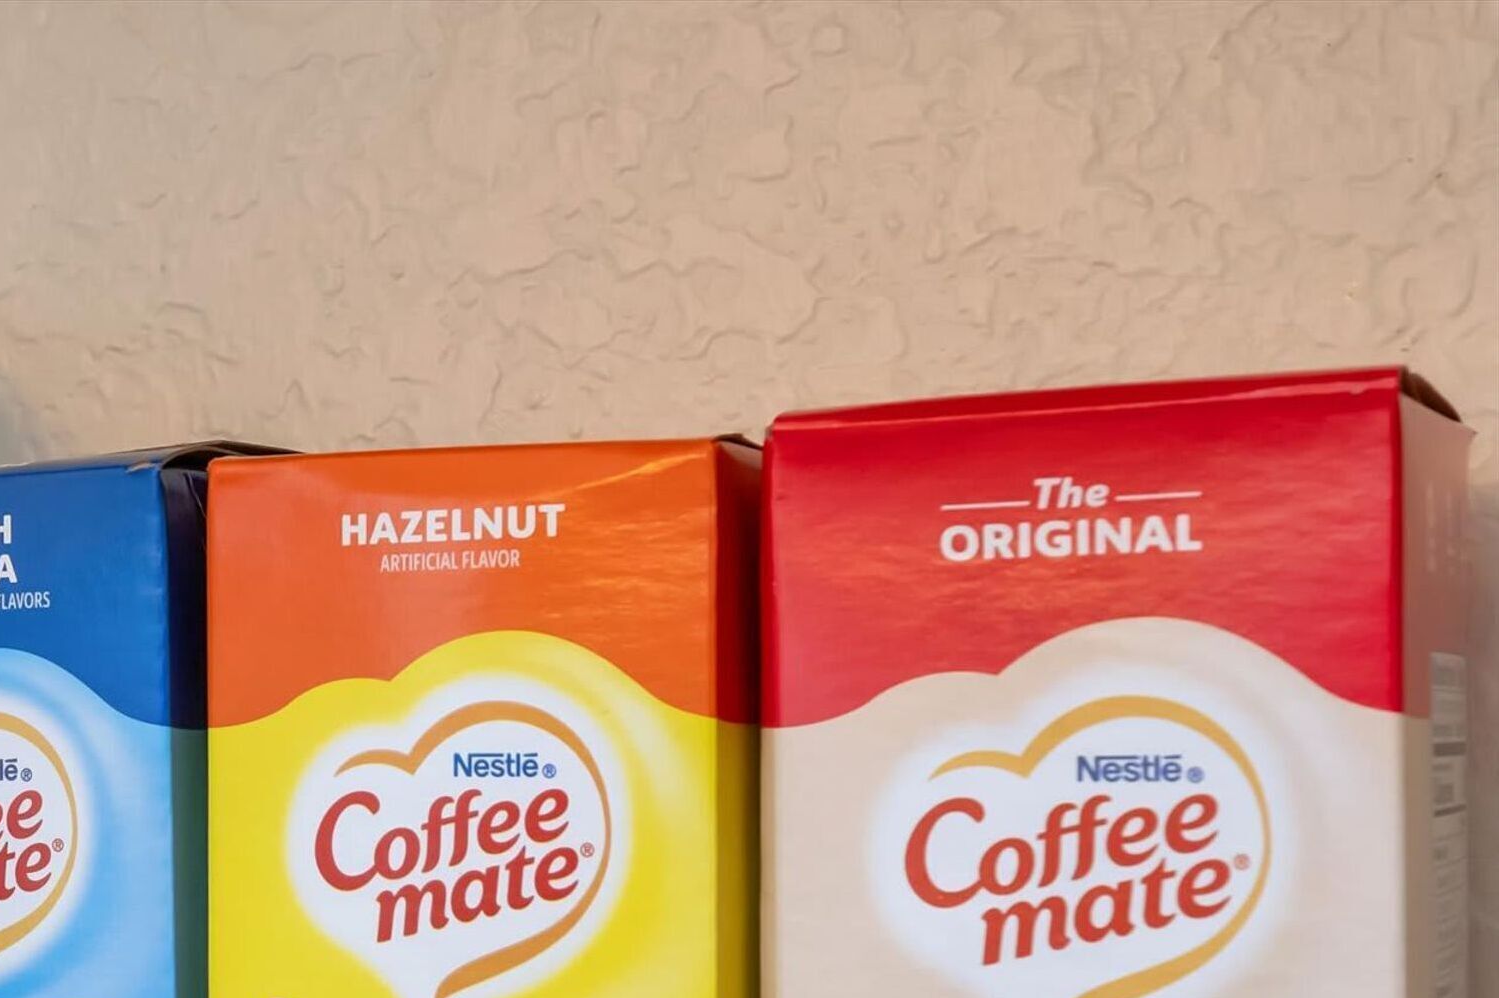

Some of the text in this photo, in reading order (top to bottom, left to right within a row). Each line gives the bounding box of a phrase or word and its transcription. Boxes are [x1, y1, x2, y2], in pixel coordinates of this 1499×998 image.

[340, 503, 566, 546] HAZELNUT
[1033, 476, 1110, 509] The
[380, 548, 520, 573] ARTIFICIAL FLAVOR
[939, 512, 1203, 563] ORIGINAL
[314, 788, 570, 891] Coffee
[904, 793, 1220, 909] Coffee
[376, 844, 580, 943] mate
[980, 856, 1233, 967] mate
